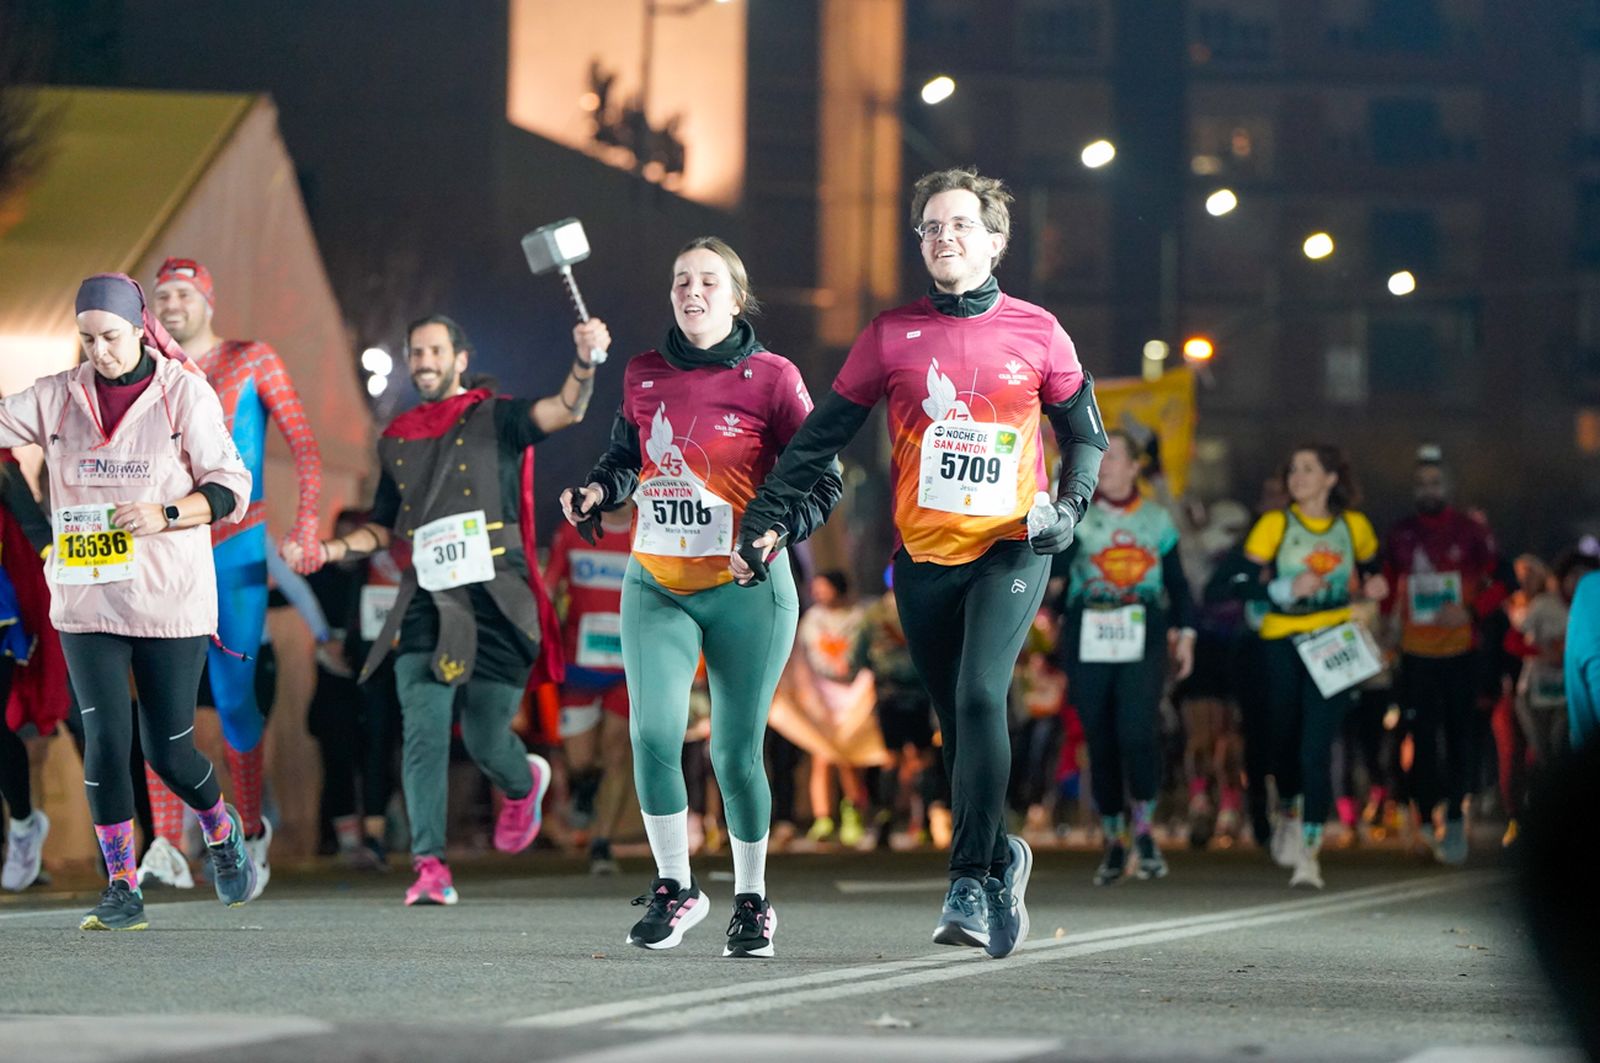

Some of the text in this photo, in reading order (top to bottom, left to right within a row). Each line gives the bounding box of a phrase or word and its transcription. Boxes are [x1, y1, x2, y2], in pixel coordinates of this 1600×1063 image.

[934, 439, 953, 450] SAN
[946, 430, 975, 442] NOCHE
[977, 433, 988, 443] DE
[660, 451, 683, 477] 43
[940, 451, 1001, 484] 5709
[643, 488, 660, 497] SAN
[652, 499, 713, 526] 5708
[64, 523, 80, 533] SAN
[65, 530, 128, 558] 13536
[433, 541, 466, 565] 307
